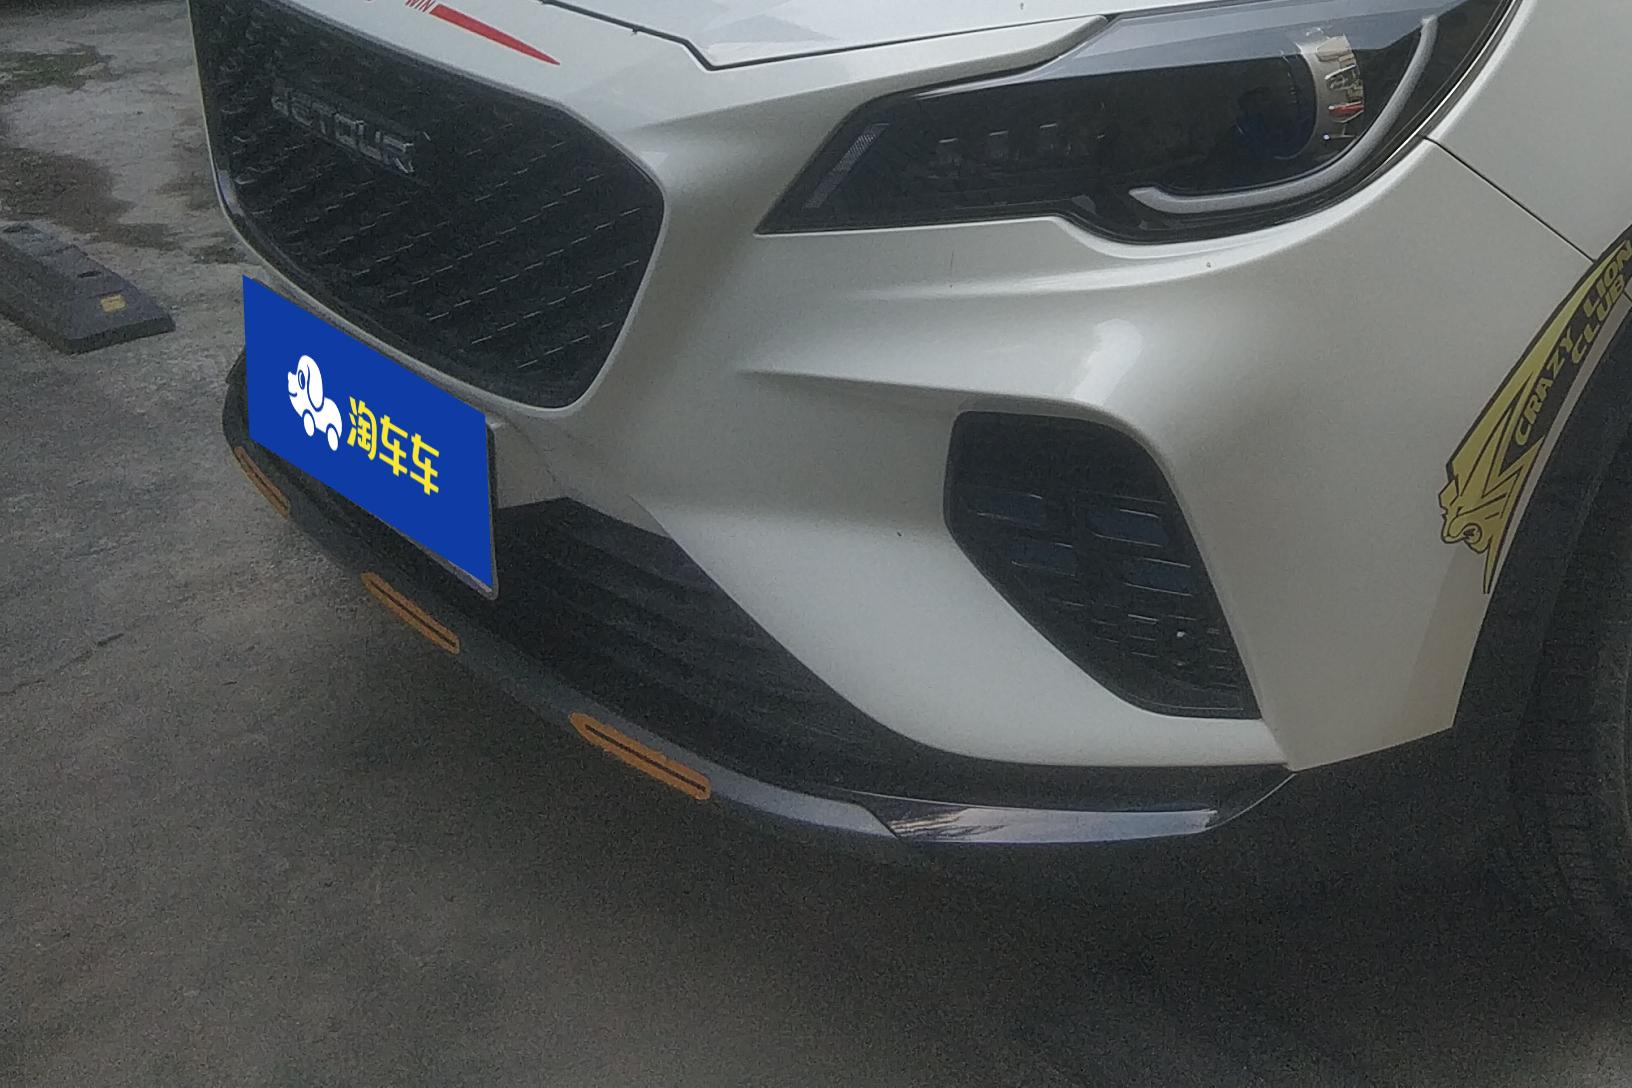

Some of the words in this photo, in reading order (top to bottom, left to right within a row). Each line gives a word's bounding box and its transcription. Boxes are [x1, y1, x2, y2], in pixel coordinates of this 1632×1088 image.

[1514, 324, 1576, 445] CRAZY
[1582, 240, 1632, 318] LION
[1570, 274, 1627, 365] CLUB
